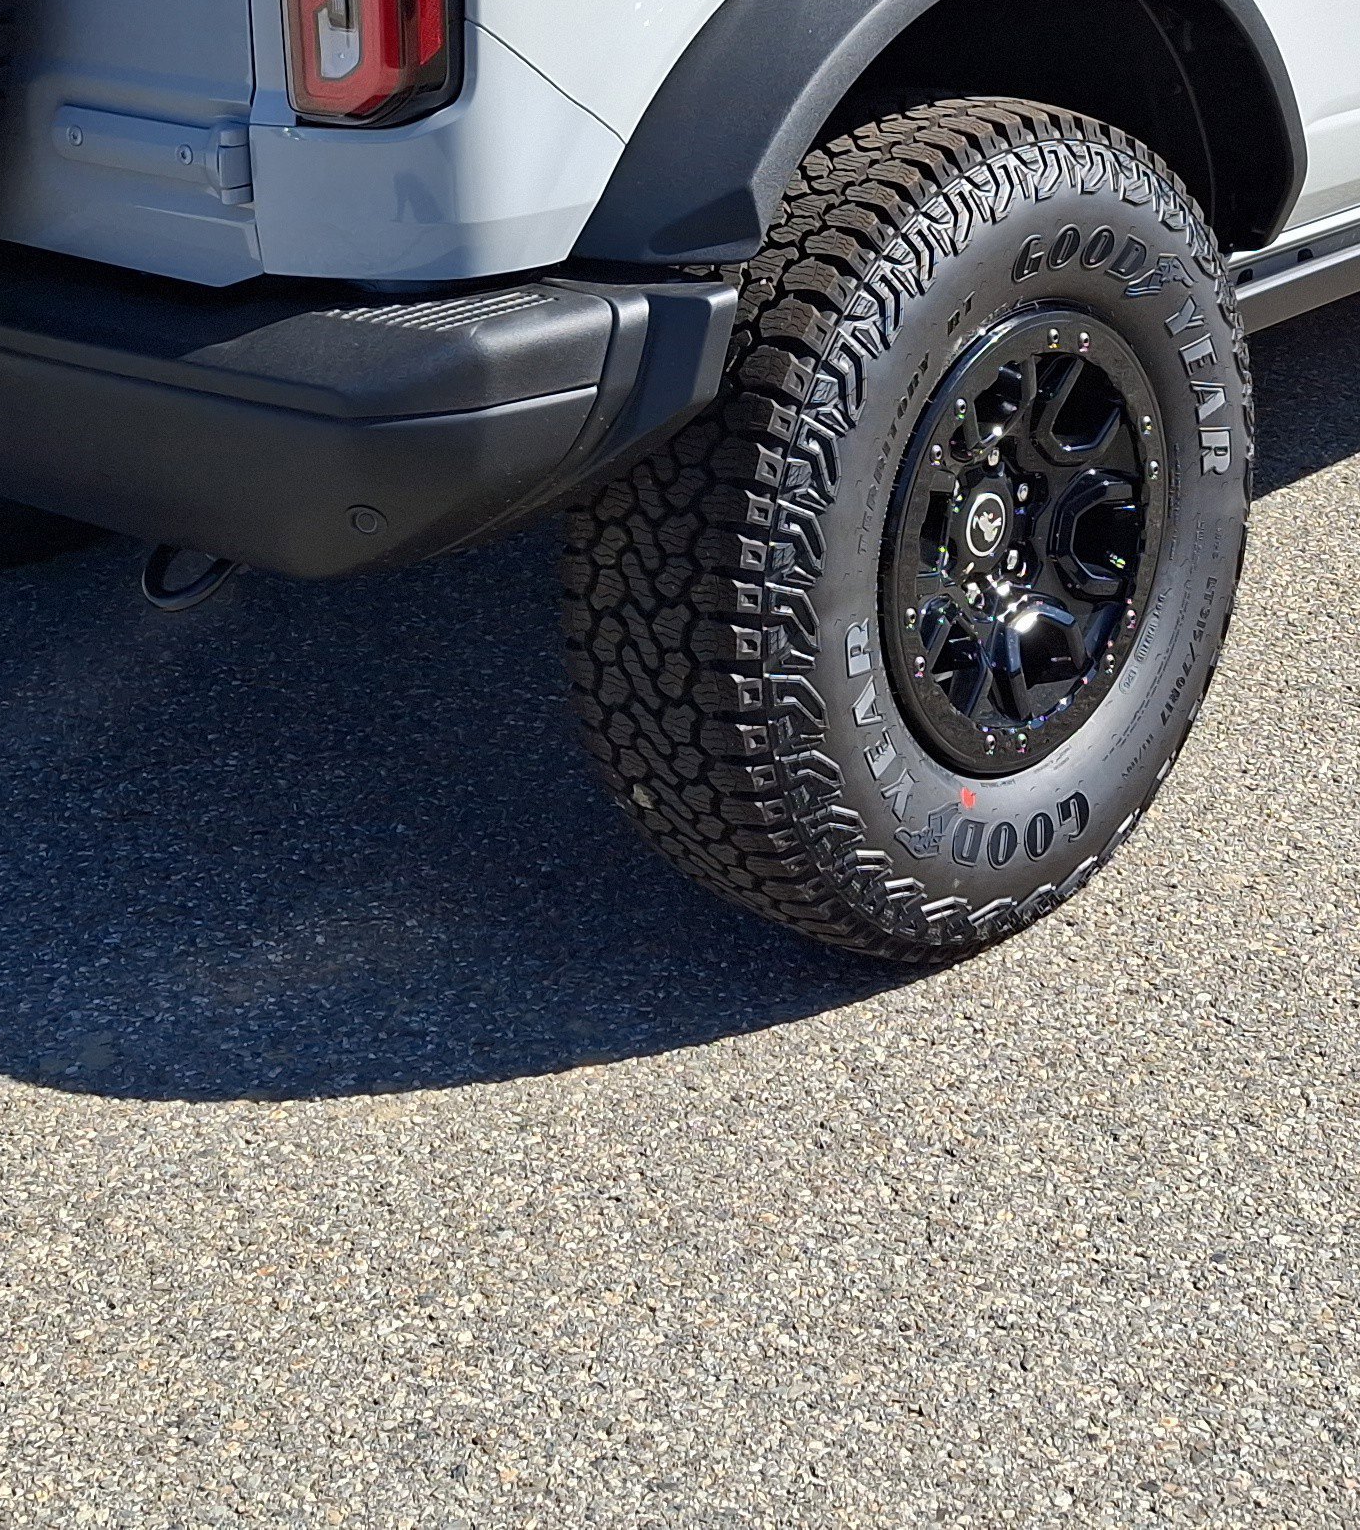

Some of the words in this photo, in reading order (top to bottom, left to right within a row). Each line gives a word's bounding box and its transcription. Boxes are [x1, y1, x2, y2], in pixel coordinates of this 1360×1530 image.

[857, 350, 930, 555] TERRITORY
[1011, 223, 1232, 476] GOODYEAR
[844, 617, 1091, 871] GOODYEAR
